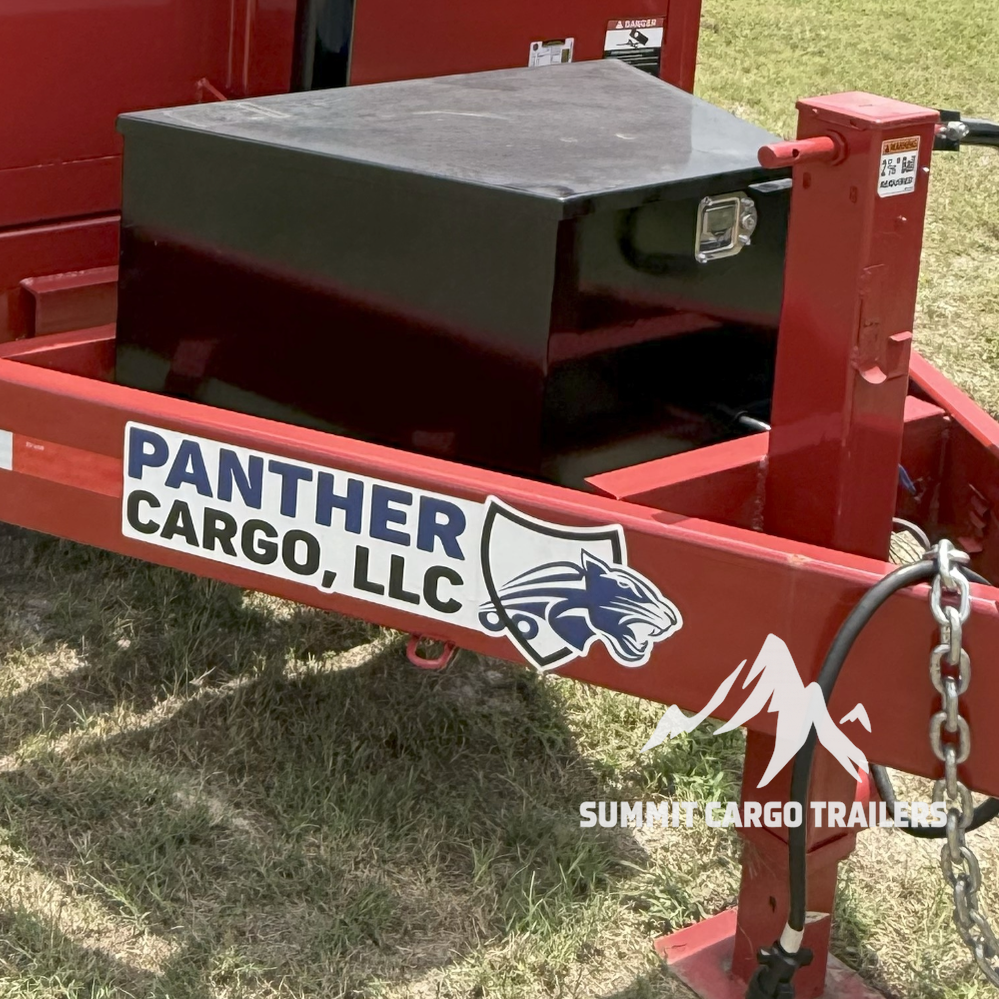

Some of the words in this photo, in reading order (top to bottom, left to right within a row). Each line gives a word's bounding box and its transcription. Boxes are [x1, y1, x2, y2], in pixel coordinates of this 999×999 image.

[126, 490, 338, 589] CARGO,
[353, 546, 464, 614] LLC
[129, 427, 466, 561] PANTHER
